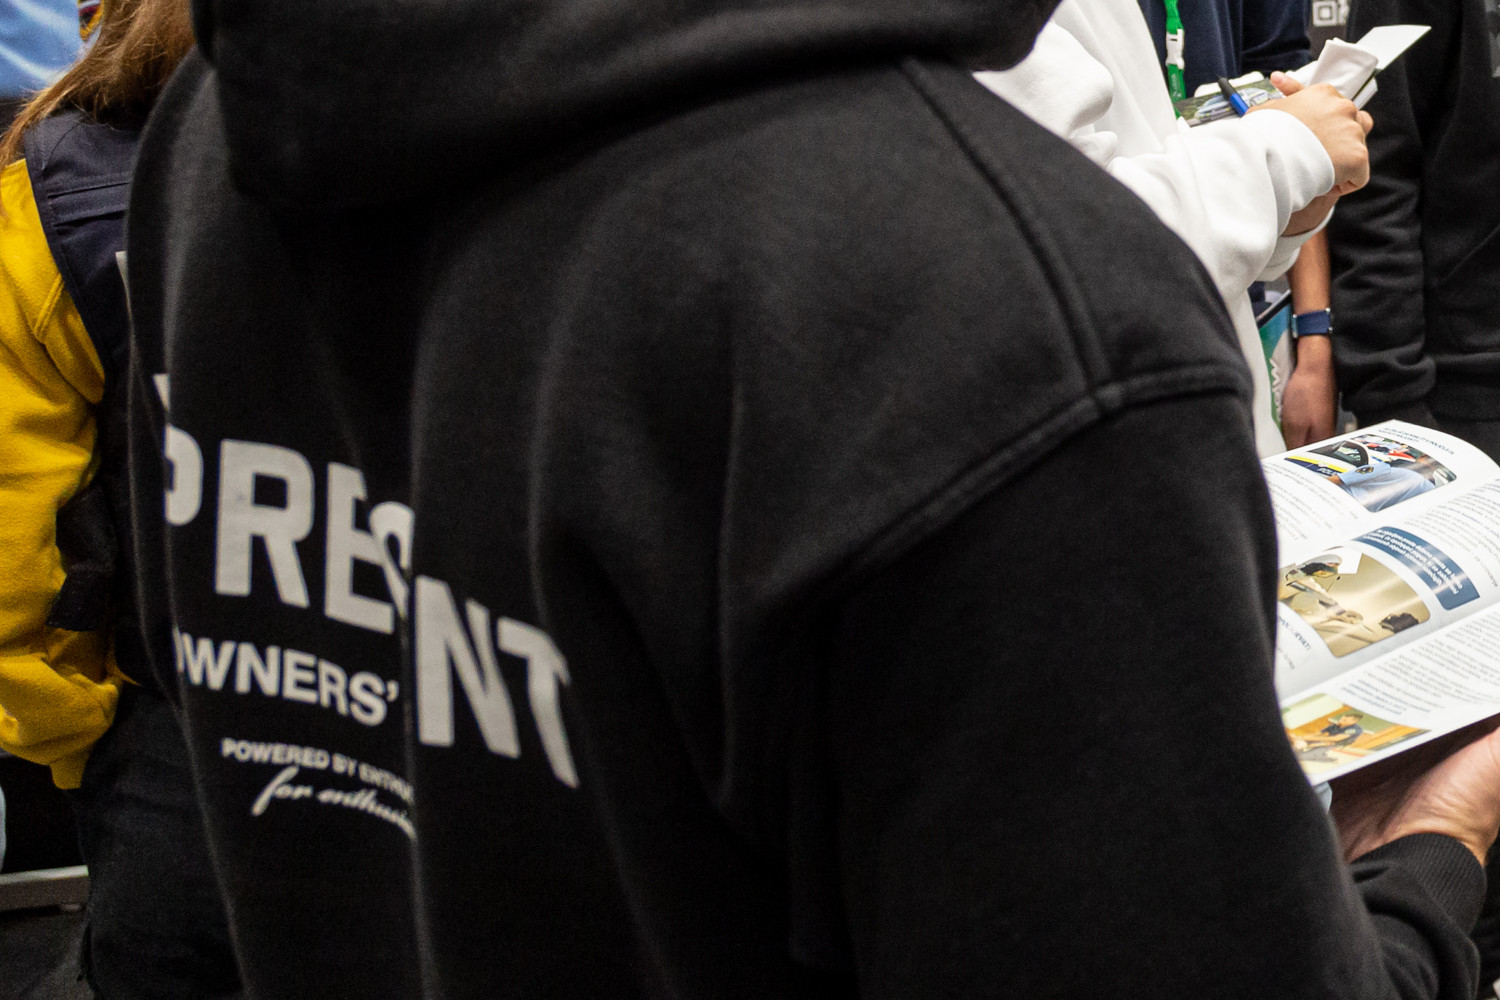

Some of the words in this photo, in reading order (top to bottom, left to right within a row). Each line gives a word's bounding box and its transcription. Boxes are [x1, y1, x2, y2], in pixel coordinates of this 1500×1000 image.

[174, 626, 400, 728] WNERS'
[221, 737, 330, 771] POWERED
[332, 753, 357, 777] BY
[252, 765, 314, 817] for
